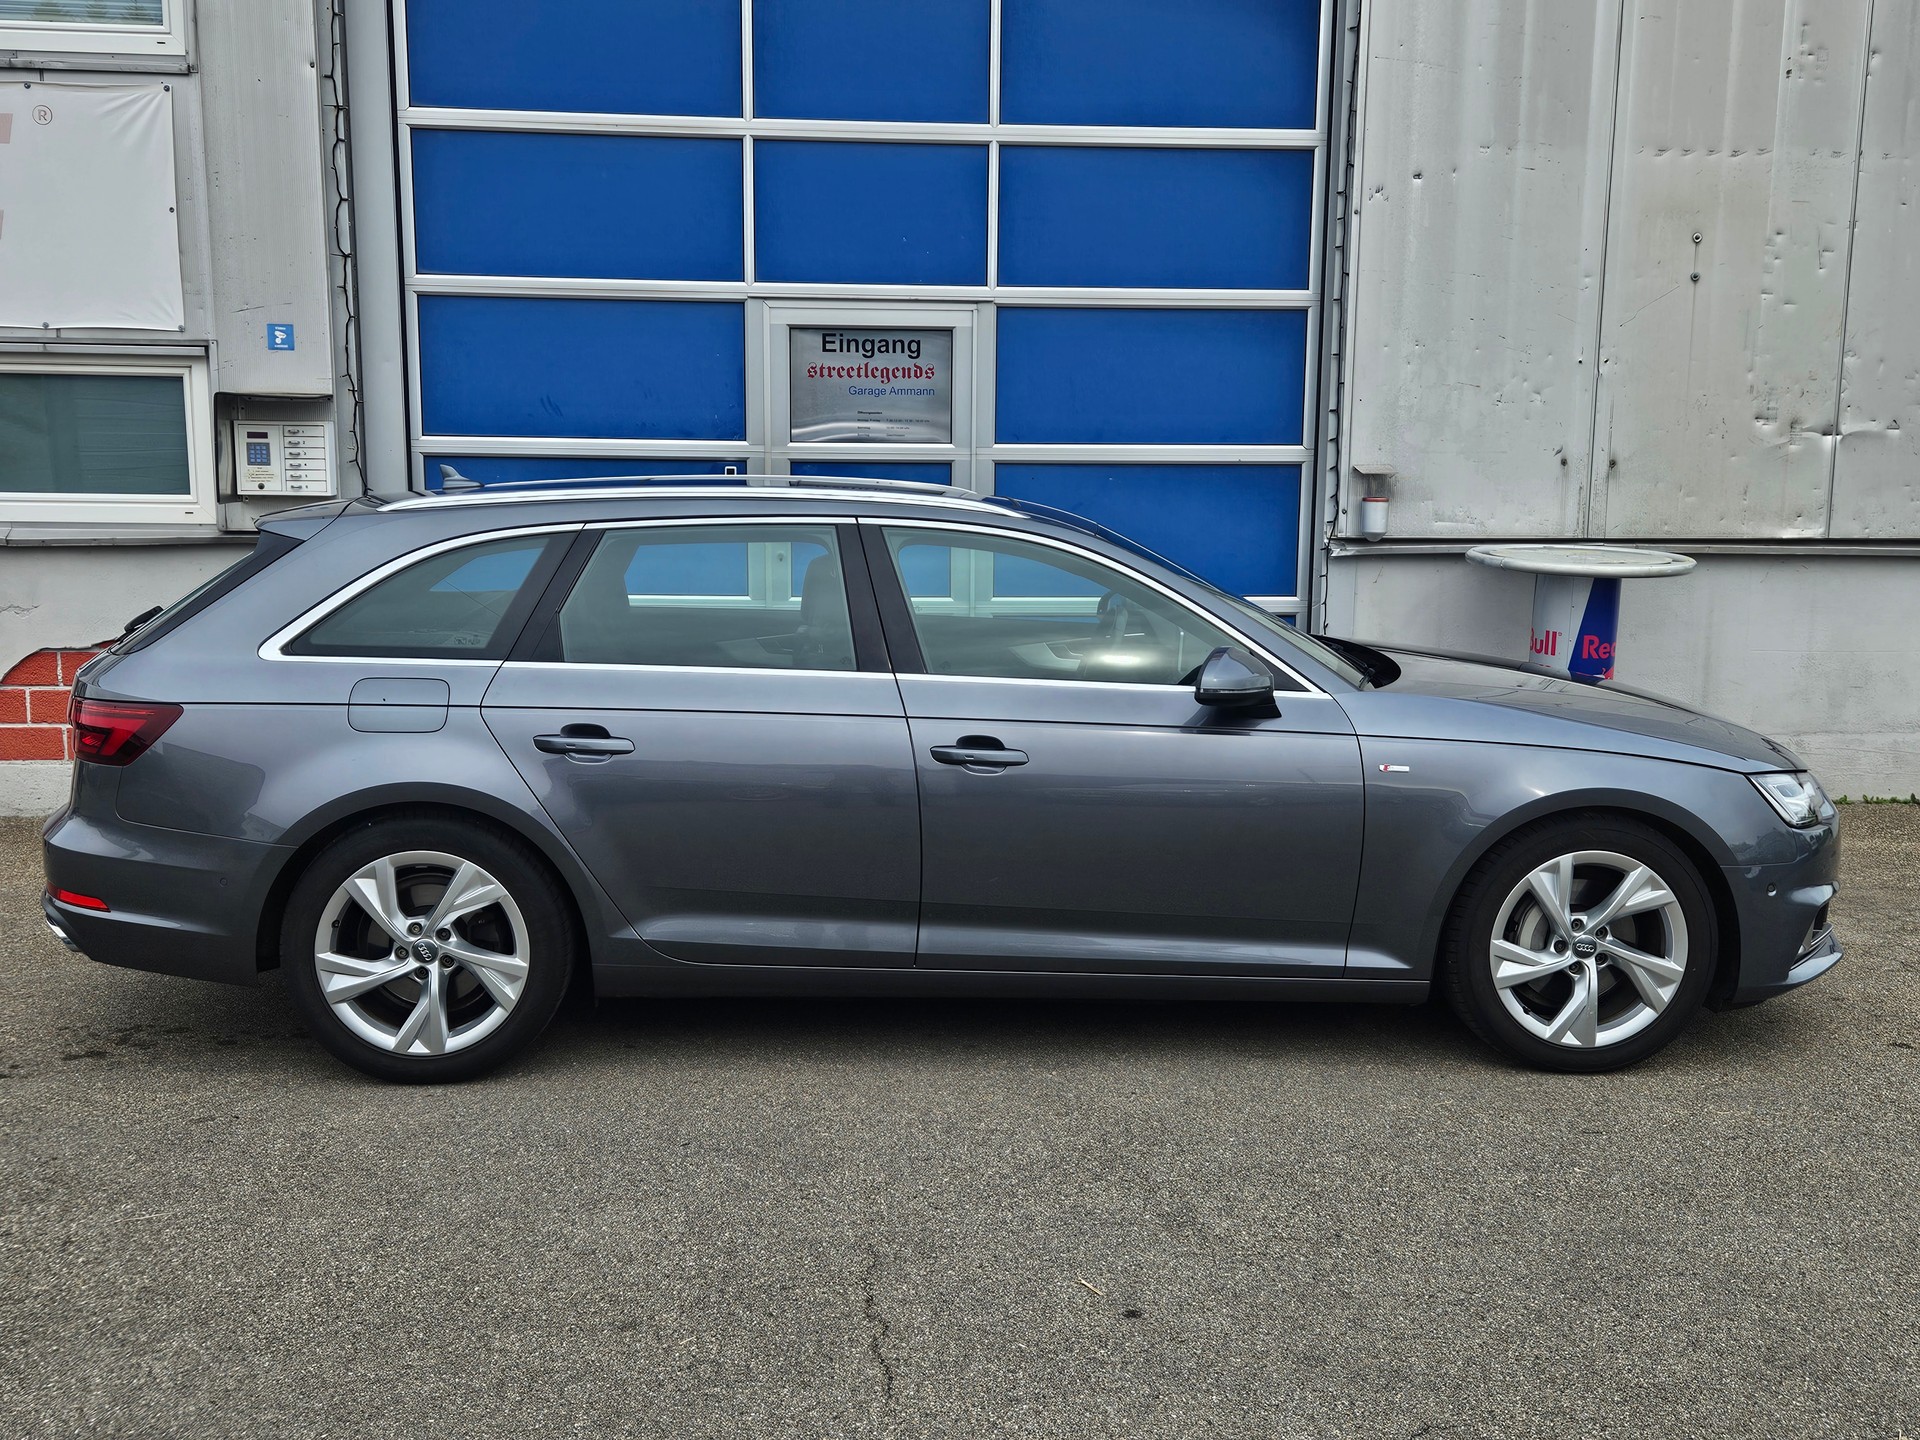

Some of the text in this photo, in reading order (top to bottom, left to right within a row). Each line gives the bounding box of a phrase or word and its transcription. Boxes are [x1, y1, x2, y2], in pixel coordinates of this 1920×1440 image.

[821, 332, 921, 360] Eingang
[807, 361, 935, 385] streetlegends
[848, 385, 935, 398] Garage Ammann
